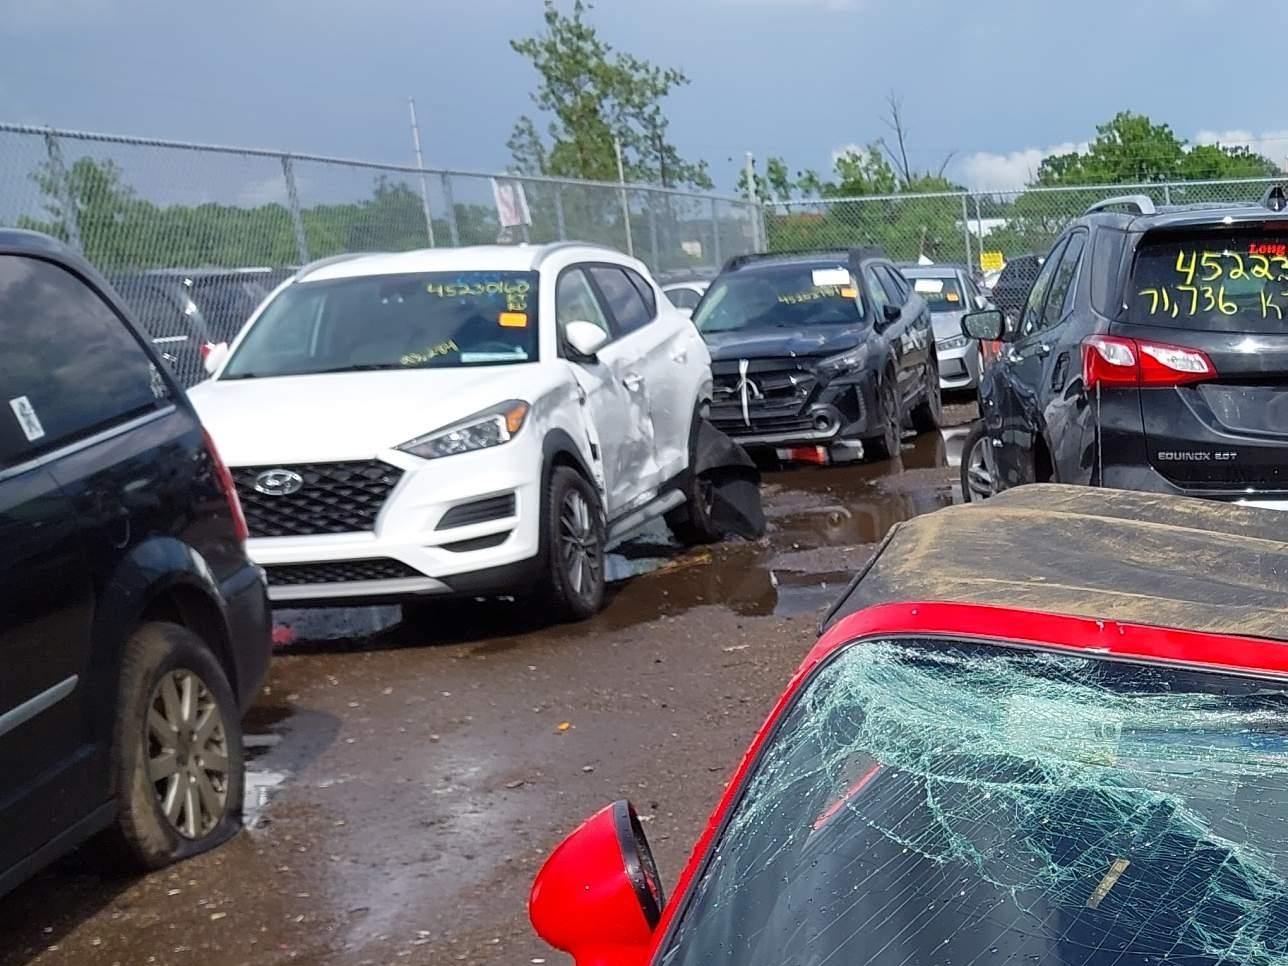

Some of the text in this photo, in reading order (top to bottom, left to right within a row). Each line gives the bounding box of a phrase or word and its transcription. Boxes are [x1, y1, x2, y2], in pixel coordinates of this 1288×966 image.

[1249, 243, 1285, 256] Long
[1138, 286, 1239, 318] 71,736
[1158, 452, 1211, 460] EQUINOX
